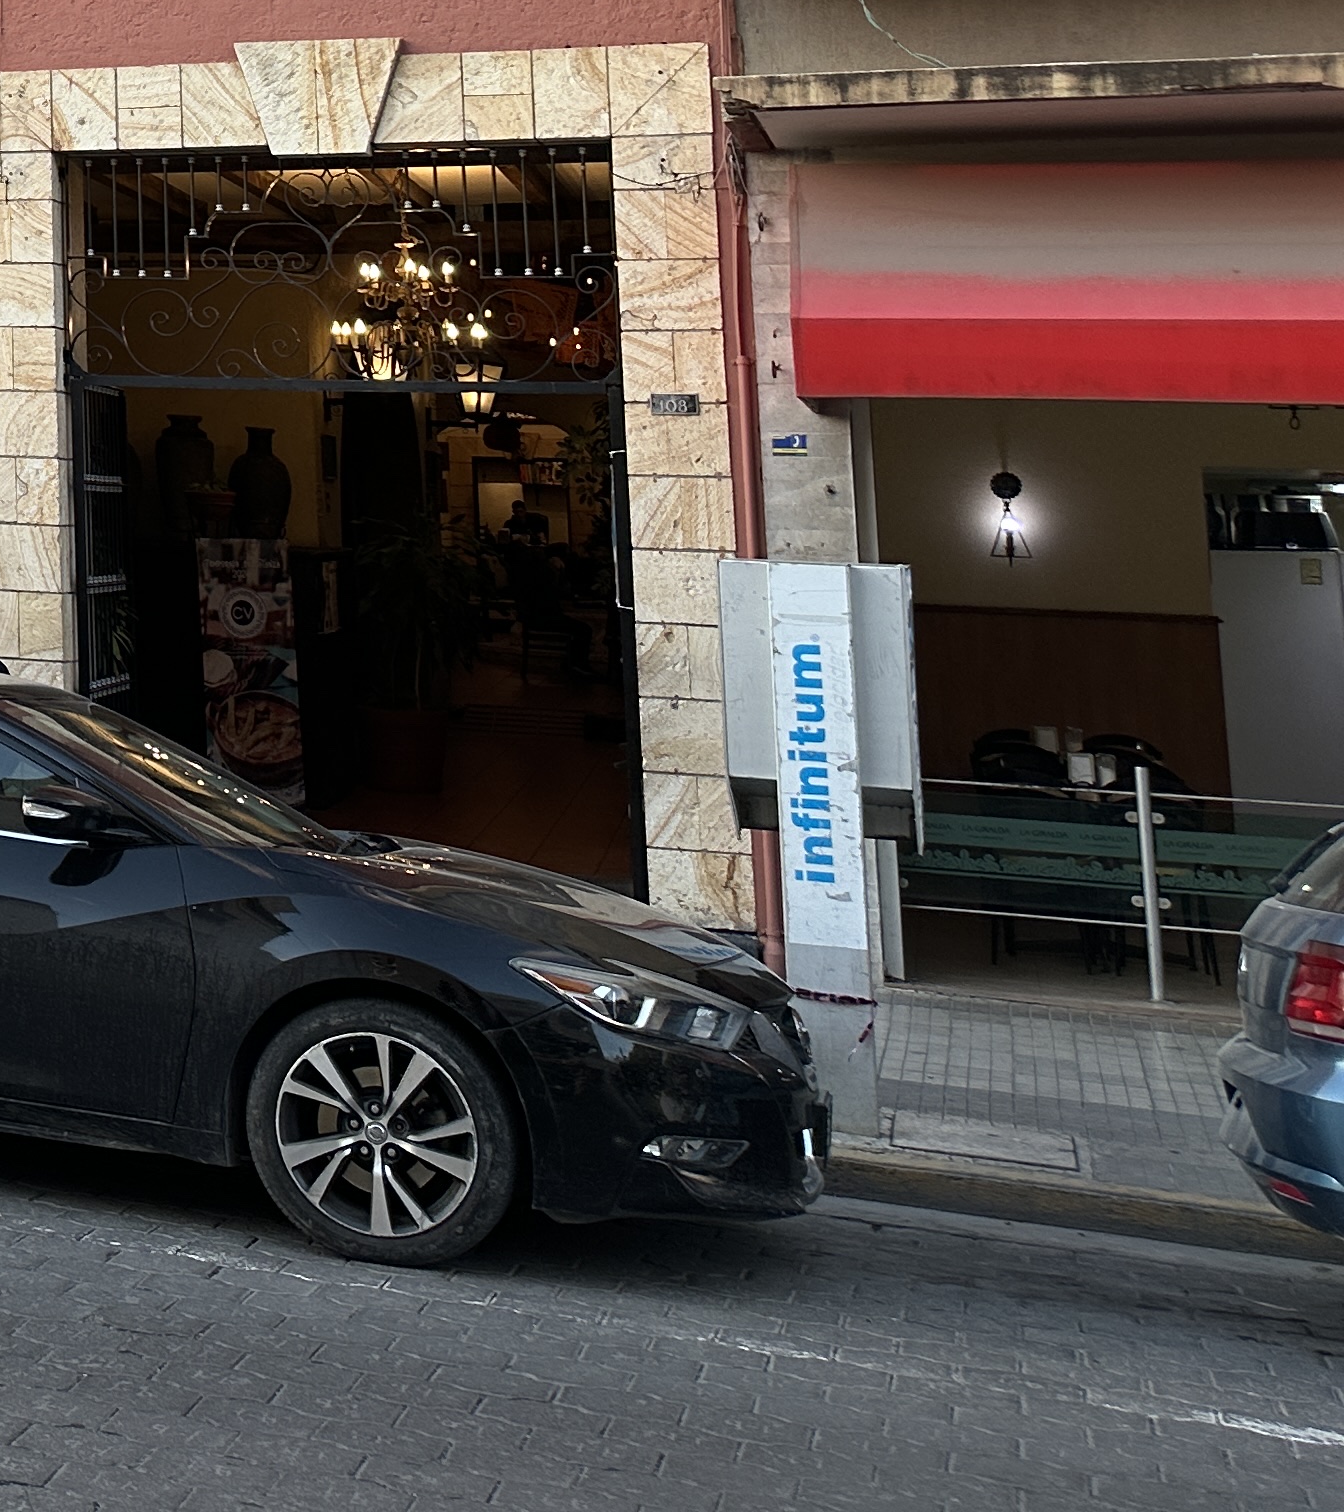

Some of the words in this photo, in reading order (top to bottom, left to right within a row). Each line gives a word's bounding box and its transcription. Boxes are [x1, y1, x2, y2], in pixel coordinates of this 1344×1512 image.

[659, 399, 689, 413] 108
[232, 606, 253, 620] CV
[788, 644, 835, 884] infinitum
